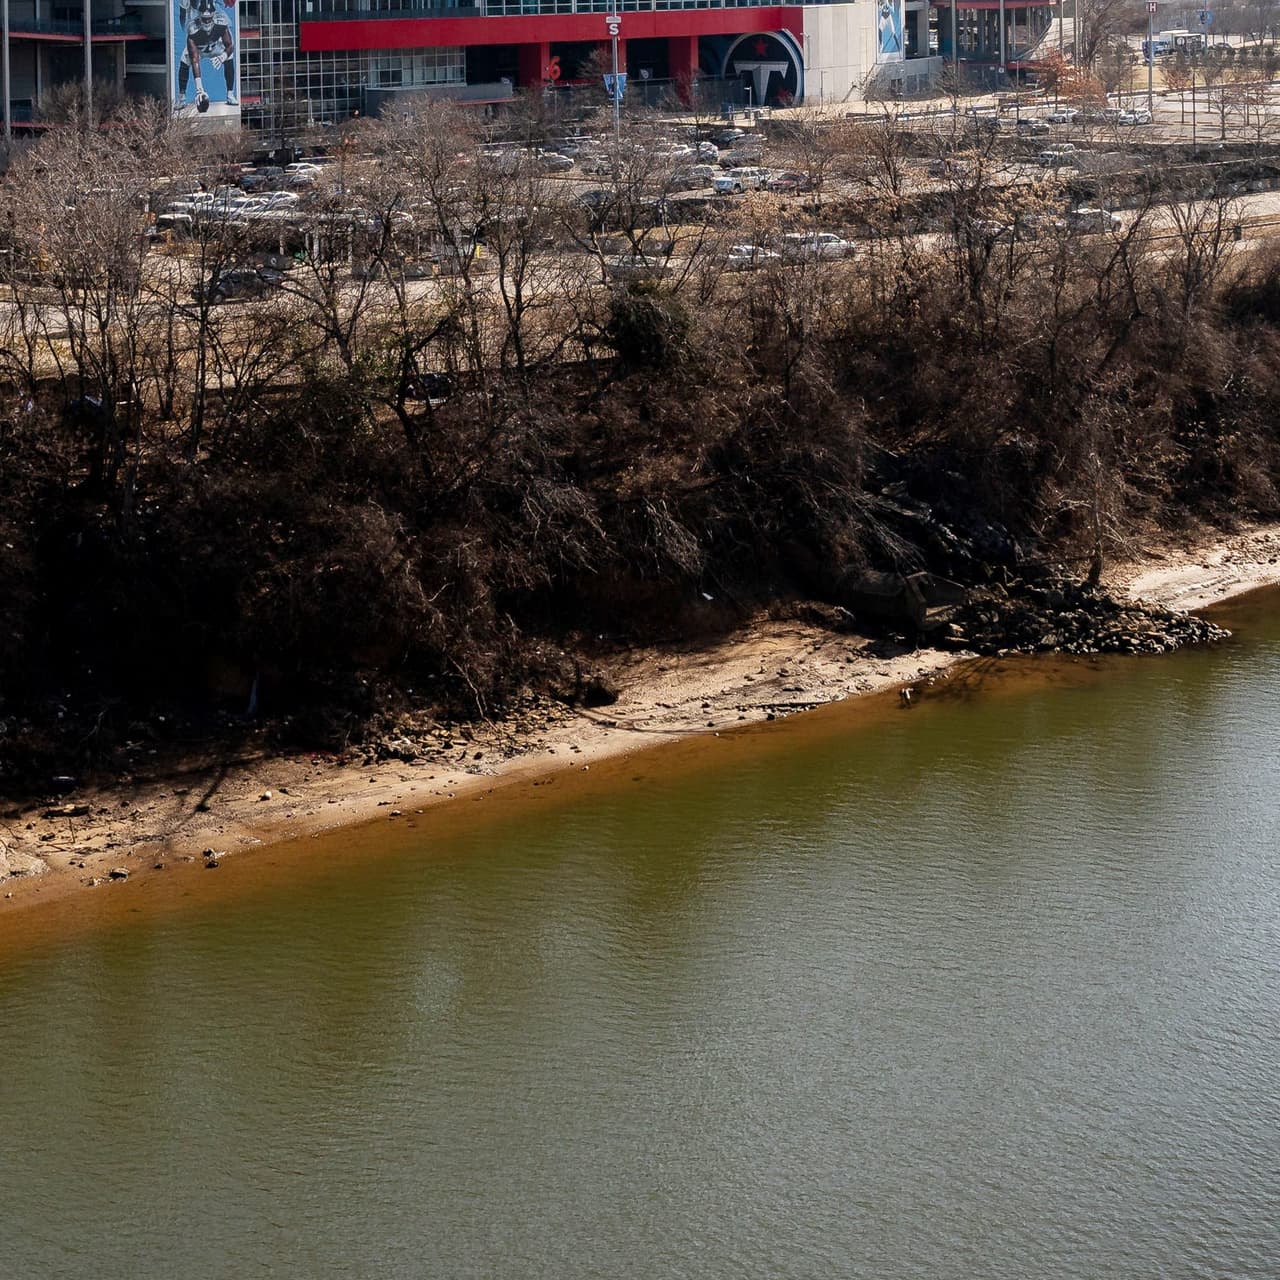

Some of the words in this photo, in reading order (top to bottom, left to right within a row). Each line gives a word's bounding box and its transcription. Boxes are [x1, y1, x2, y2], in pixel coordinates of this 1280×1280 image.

[1149, 3, 1156, 12] H
[609, 24, 619, 35] S
[549, 56, 561, 81] 6
